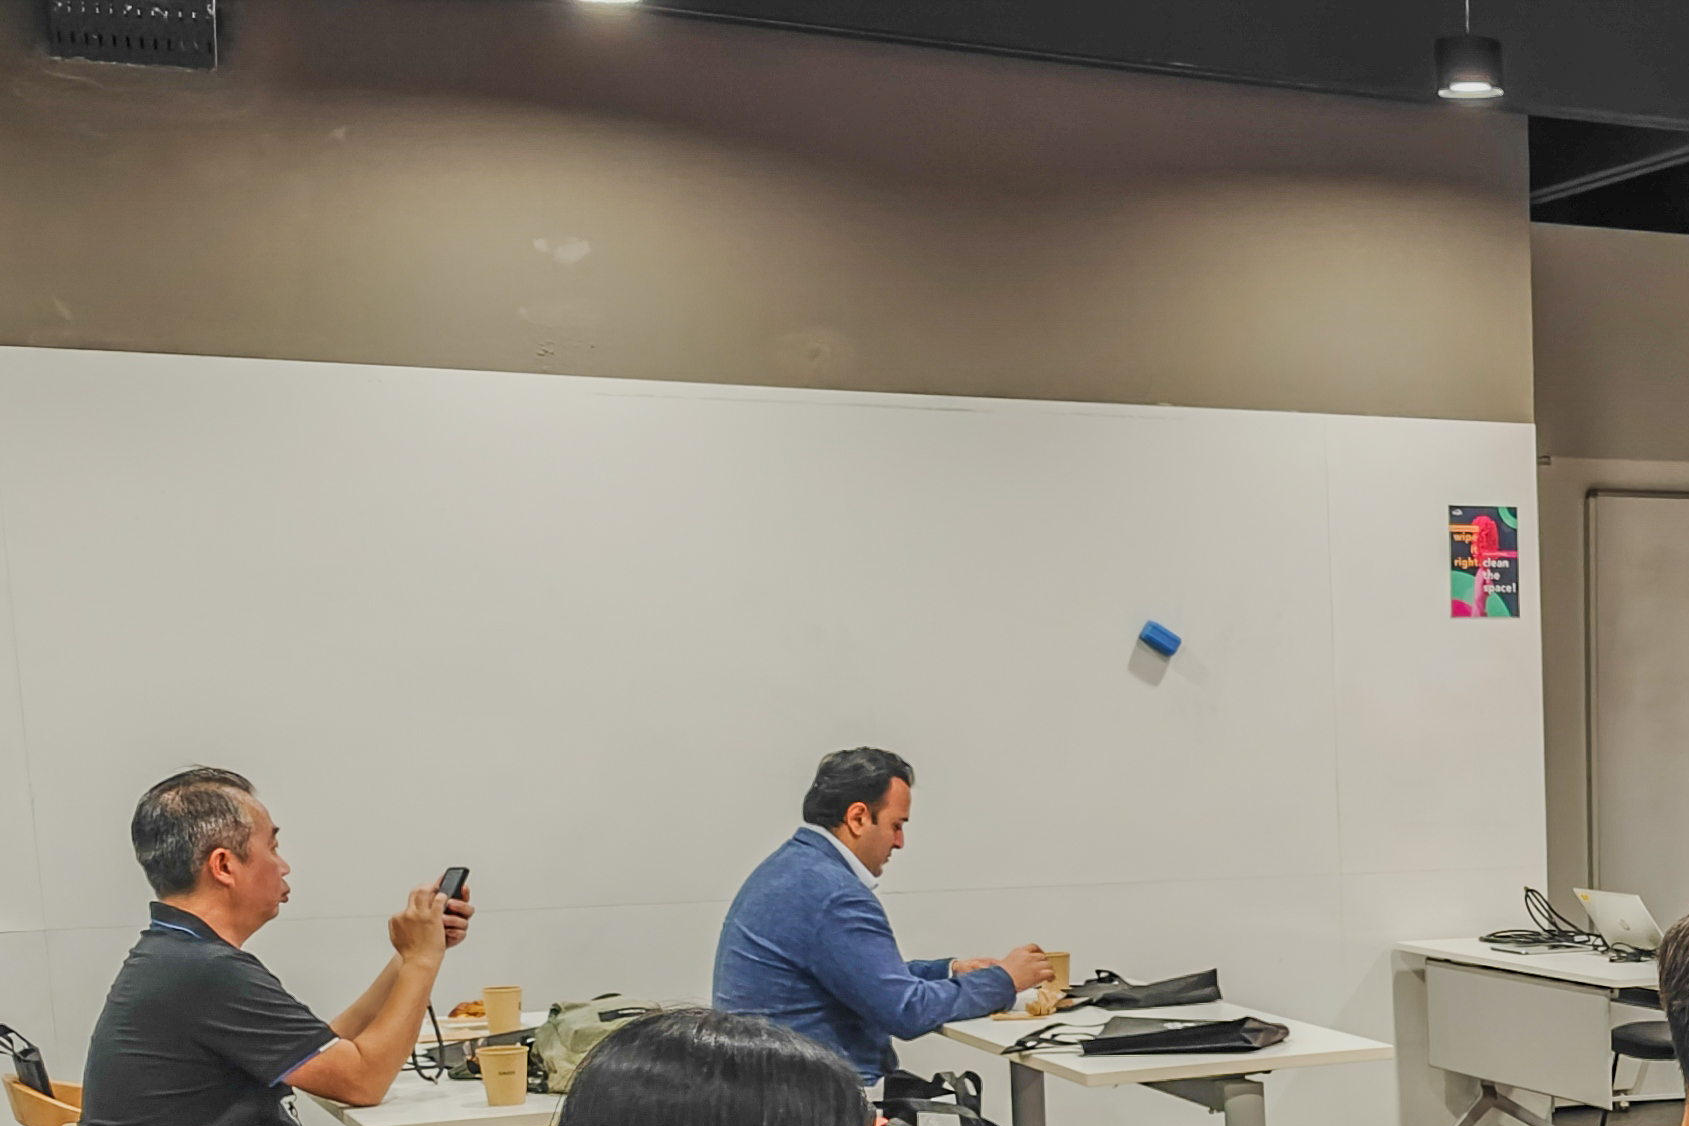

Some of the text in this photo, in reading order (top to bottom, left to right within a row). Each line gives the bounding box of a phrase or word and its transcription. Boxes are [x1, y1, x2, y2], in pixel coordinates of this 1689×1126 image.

[1482, 557, 1510, 568] clean
[1482, 569, 1501, 581] the
[1483, 582, 1517, 595] space!
